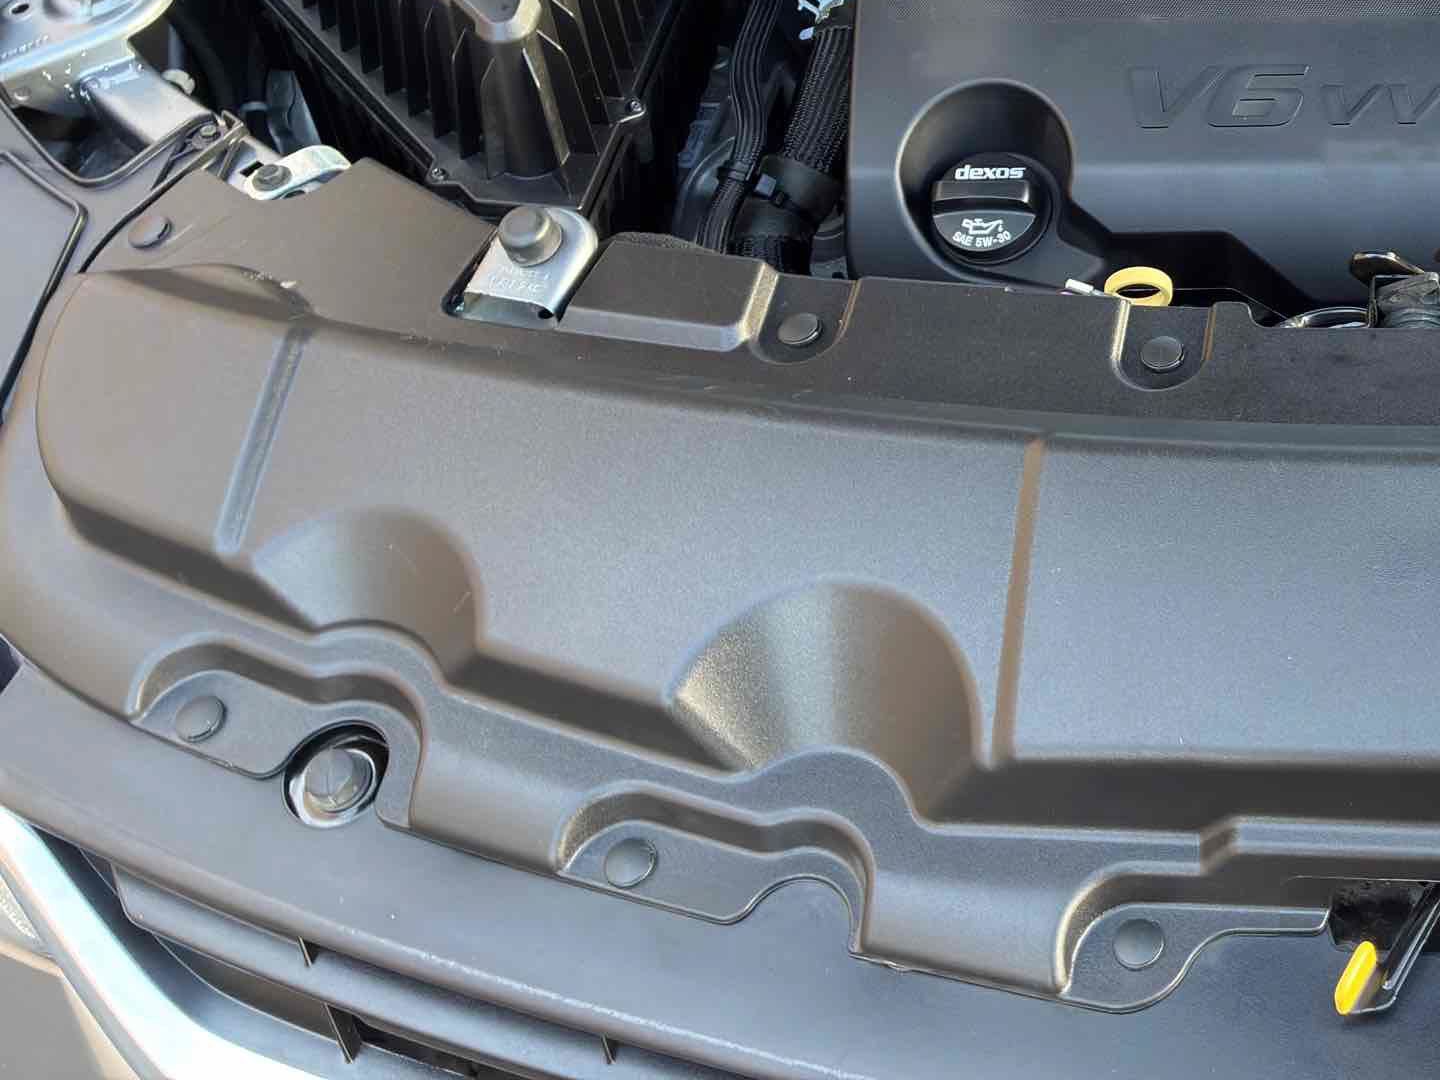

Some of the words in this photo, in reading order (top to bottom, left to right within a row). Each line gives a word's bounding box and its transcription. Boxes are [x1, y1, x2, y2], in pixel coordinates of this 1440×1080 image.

[1124, 64, 1312, 129] V6
[955, 164, 1026, 180] dexos
[952, 232, 974, 246] SAE
[975, 231, 1011, 247] 5W-30
